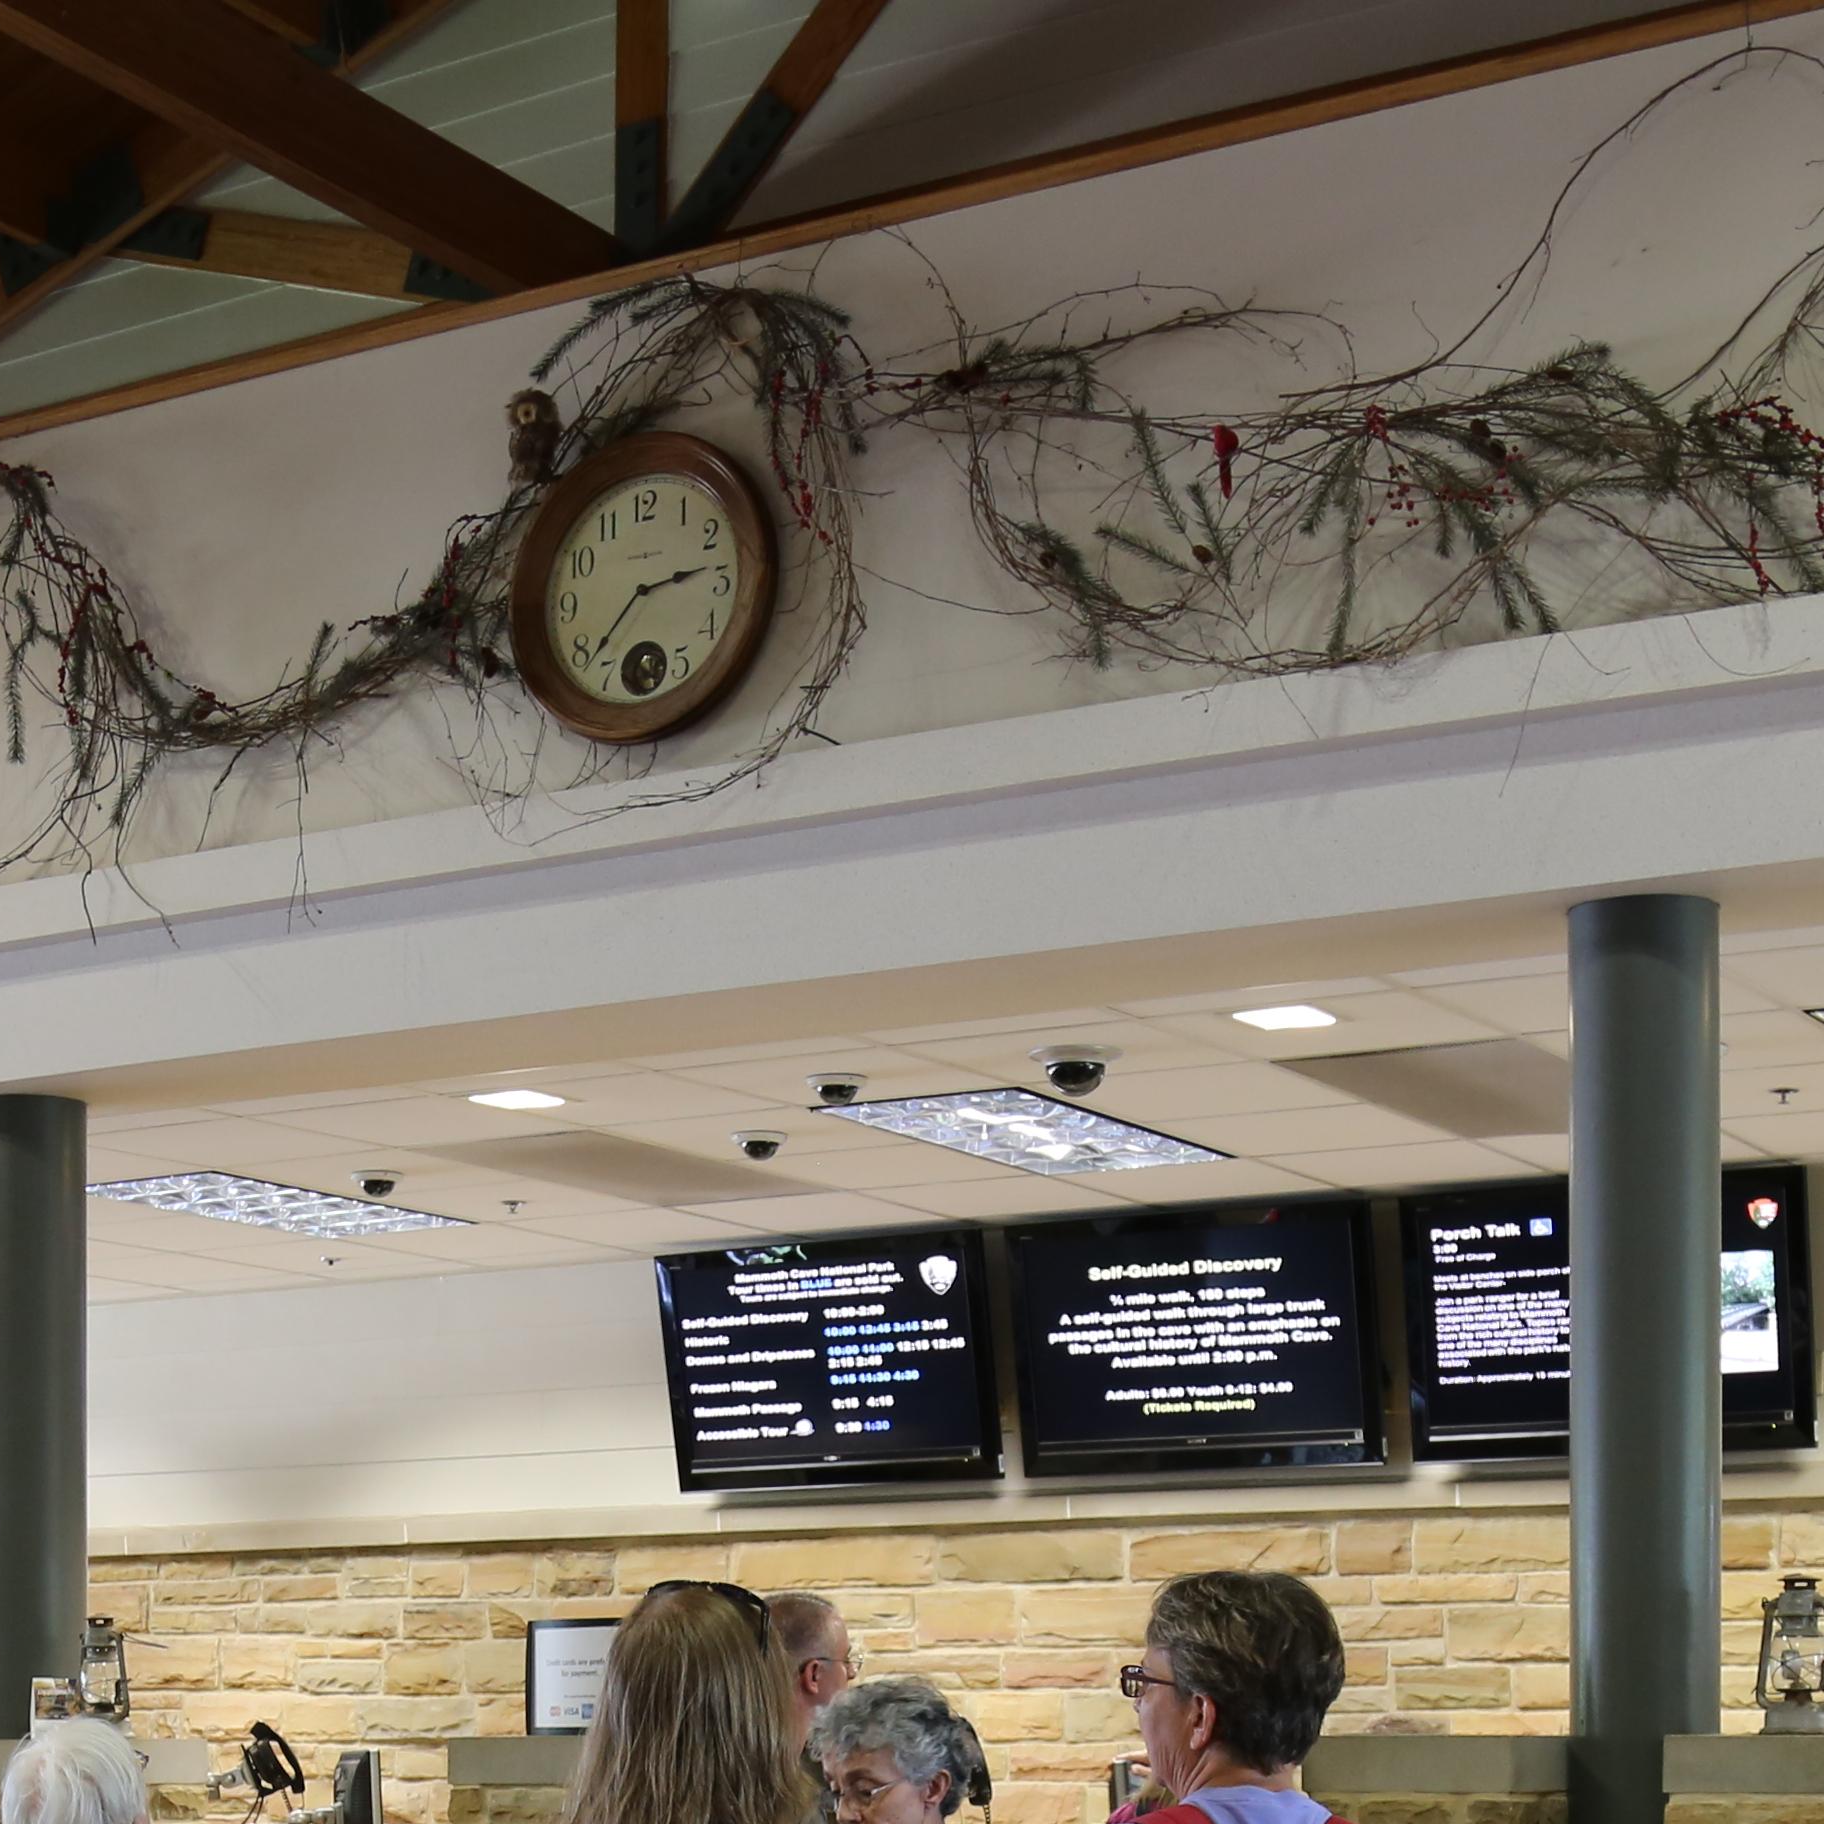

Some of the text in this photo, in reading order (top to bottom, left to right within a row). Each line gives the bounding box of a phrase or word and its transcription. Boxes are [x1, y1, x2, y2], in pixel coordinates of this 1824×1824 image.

[634, 490, 657, 523] 12
[680, 496, 687, 526] 1
[600, 511, 616, 541] 11
[703, 519, 719, 550] 2
[572, 546, 594, 579] 10
[713, 565, 730, 596] 3
[560, 592, 577, 624] 9
[698, 609, 718, 640] 4
[572, 634, 589, 667] 8
[672, 645, 689, 679] 5
[600, 659, 616, 691] 7
[1430, 1223, 1521, 1241] Porch Talk
[1433, 1243, 1458, 1254] 3:00
[1435, 1253, 1496, 1263] Free of Charge
[734, 1262, 894, 1283] Mammoth Cave National Park
[1088, 1257, 1282, 1281] Self-Guided Discovery
[728, 1273, 904, 1296] Tour times in BLUE are sold out.
[1126, 1293, 1154, 1305] mile
[1159, 1291, 1194, 1304] walk,
[1226, 1287, 1265, 1302] steps
[682, 1311, 808, 1330] Self-Guided Discovery
[1060, 1300, 1325, 1327] A self-guided walk through large trunk
[859, 1323, 890, 1335] 12:45
[921, 1319, 948, 1331] 3:45
[1048, 1317, 1340, 1344] passages in the cave with an emphasis on
[684, 1334, 730, 1348] Historic
[897, 1340, 928, 1352] 12:15
[932, 1338, 965, 1350] 12:45
[1068, 1332, 1332, 1354] the cultural history of Mammoth Cave.
[686, 1349, 815, 1367] Domes and Dripstones
[828, 1355, 882, 1368] 2:15 2:45
[1111, 1350, 1277, 1369] Available until 2:00 p.m.
[858, 1372, 890, 1383] 11:30
[893, 1370, 919, 1382] 4:30
[690, 1380, 776, 1394] Frozen Niagara
[1105, 1388, 1150, 1401] Adults:
[1187, 1385, 1222, 1397] Youth
[1225, 1383, 1256, 1396] 6-12:
[1259, 1382, 1293, 1394] $4.00
[694, 1402, 802, 1418] Mammoth Passage
[867, 1395, 894, 1408] 4:15
[1143, 1399, 1255, 1415] (Tickets Required)
[697, 1426, 788, 1442] Accessible Tour
